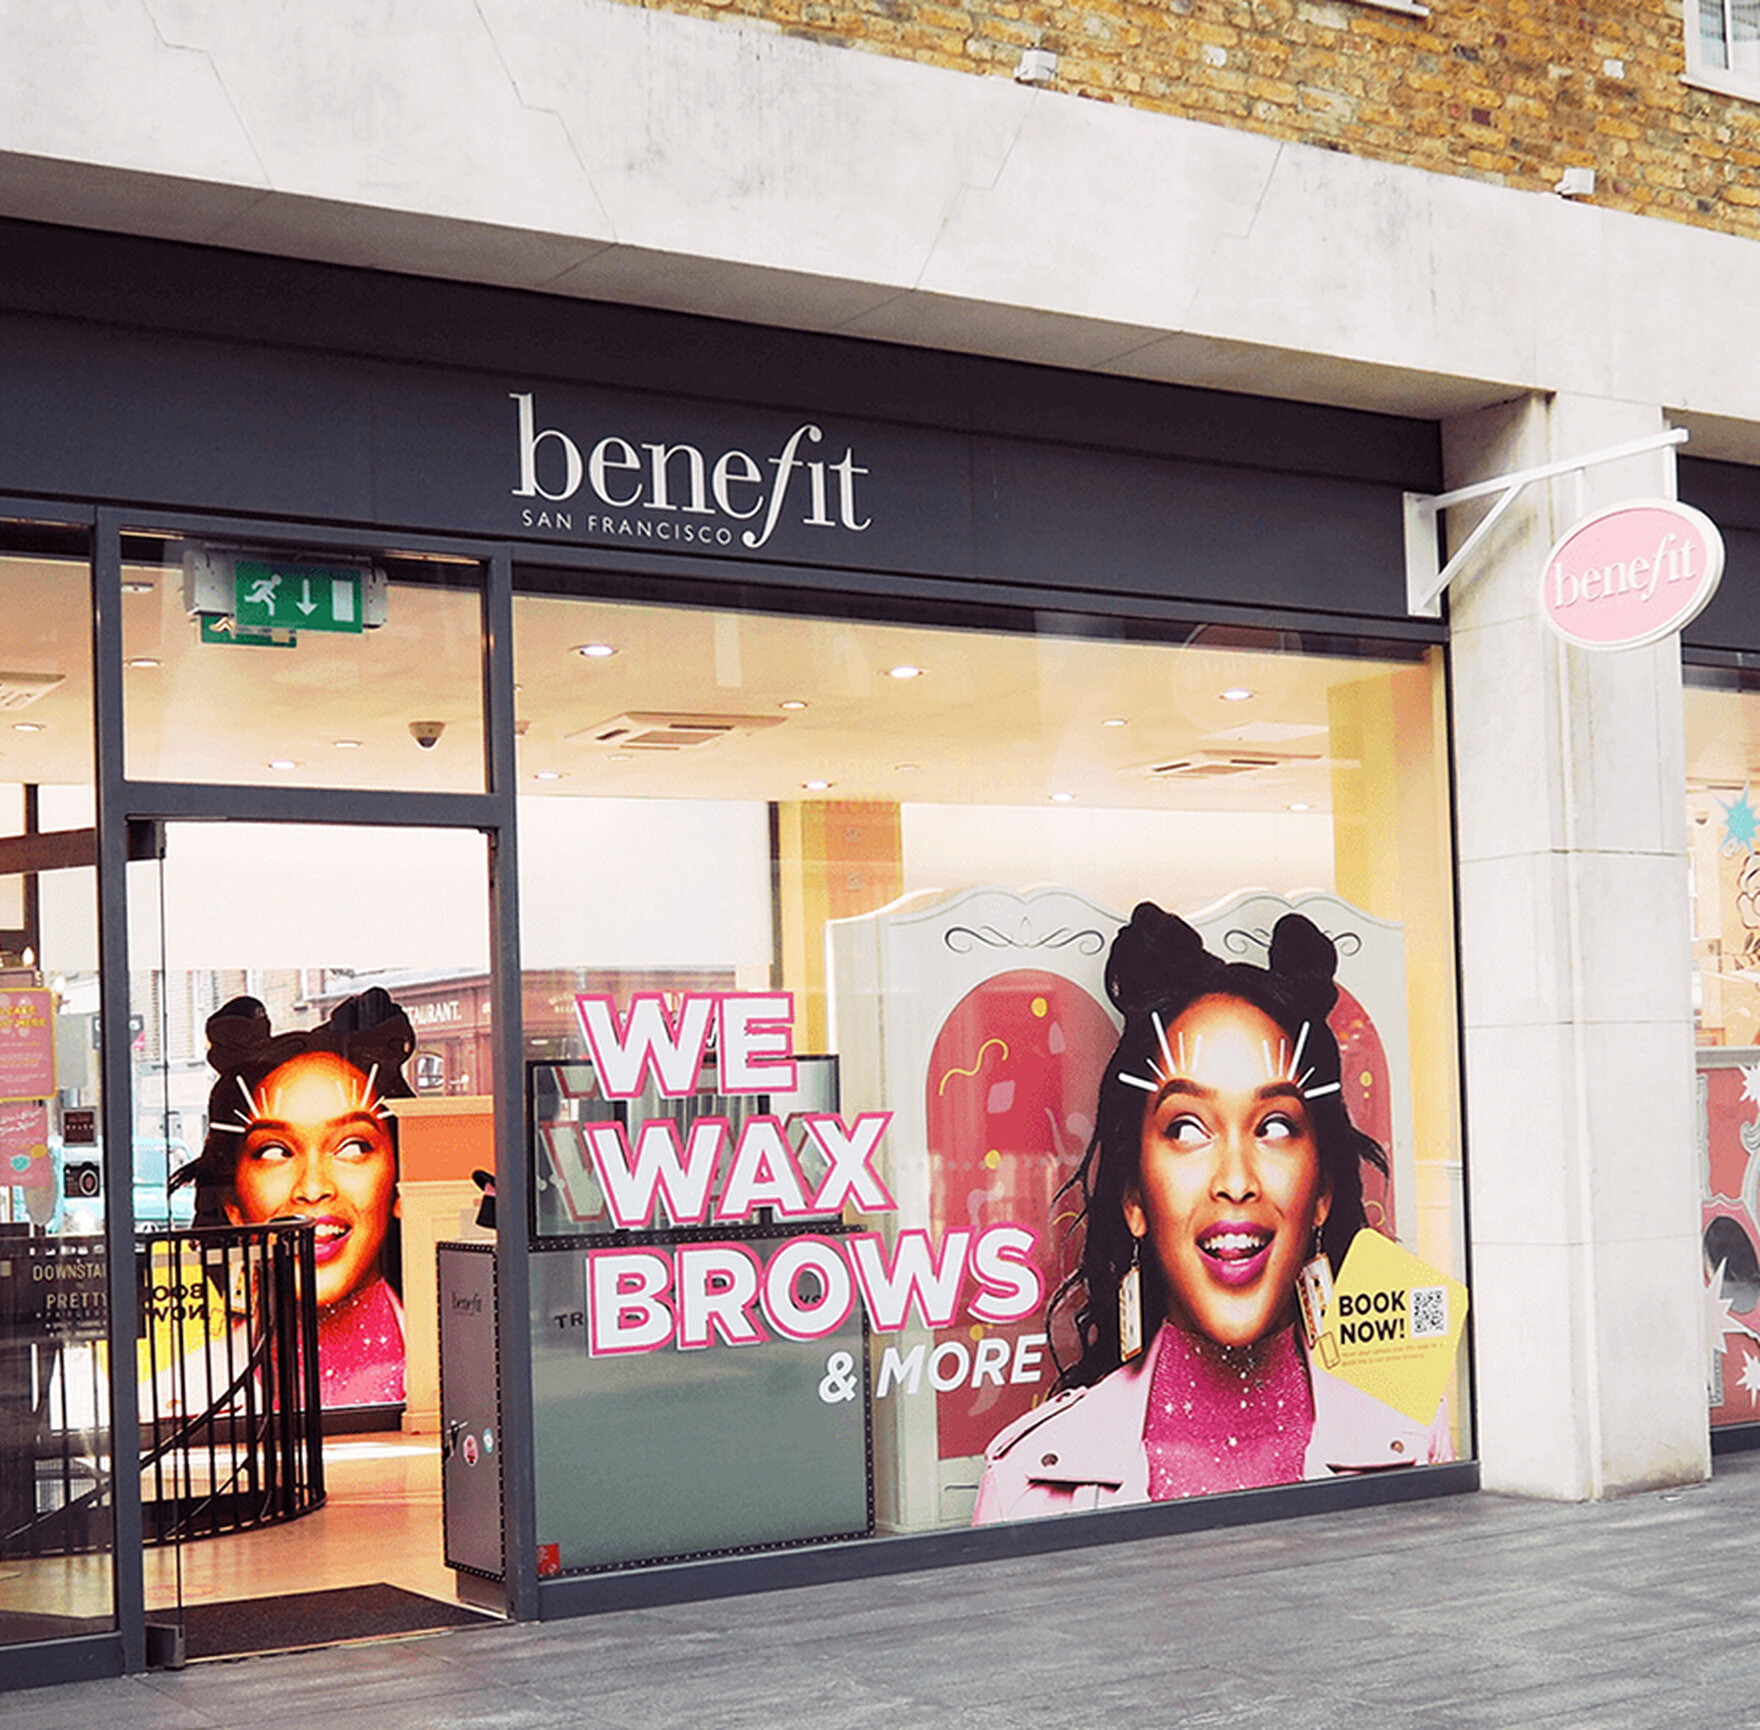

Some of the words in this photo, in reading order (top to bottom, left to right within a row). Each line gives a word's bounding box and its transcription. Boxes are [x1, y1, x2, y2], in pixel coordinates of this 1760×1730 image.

[509, 392, 872, 548] benefit
[522, 509, 572, 530] SAN
[588, 515, 733, 545] FRANCISCO
[1552, 533, 1697, 610] benefit
[575, 990, 798, 1101] WE
[584, 1111, 898, 1229] WAX
[586, 1222, 1044, 1358] BROWS
[1338, 1290, 1406, 1317] BOOK
[818, 1351, 857, 1404] &
[876, 1333, 1048, 1398] MORE
[1340, 1318, 1405, 1345] NOW!
